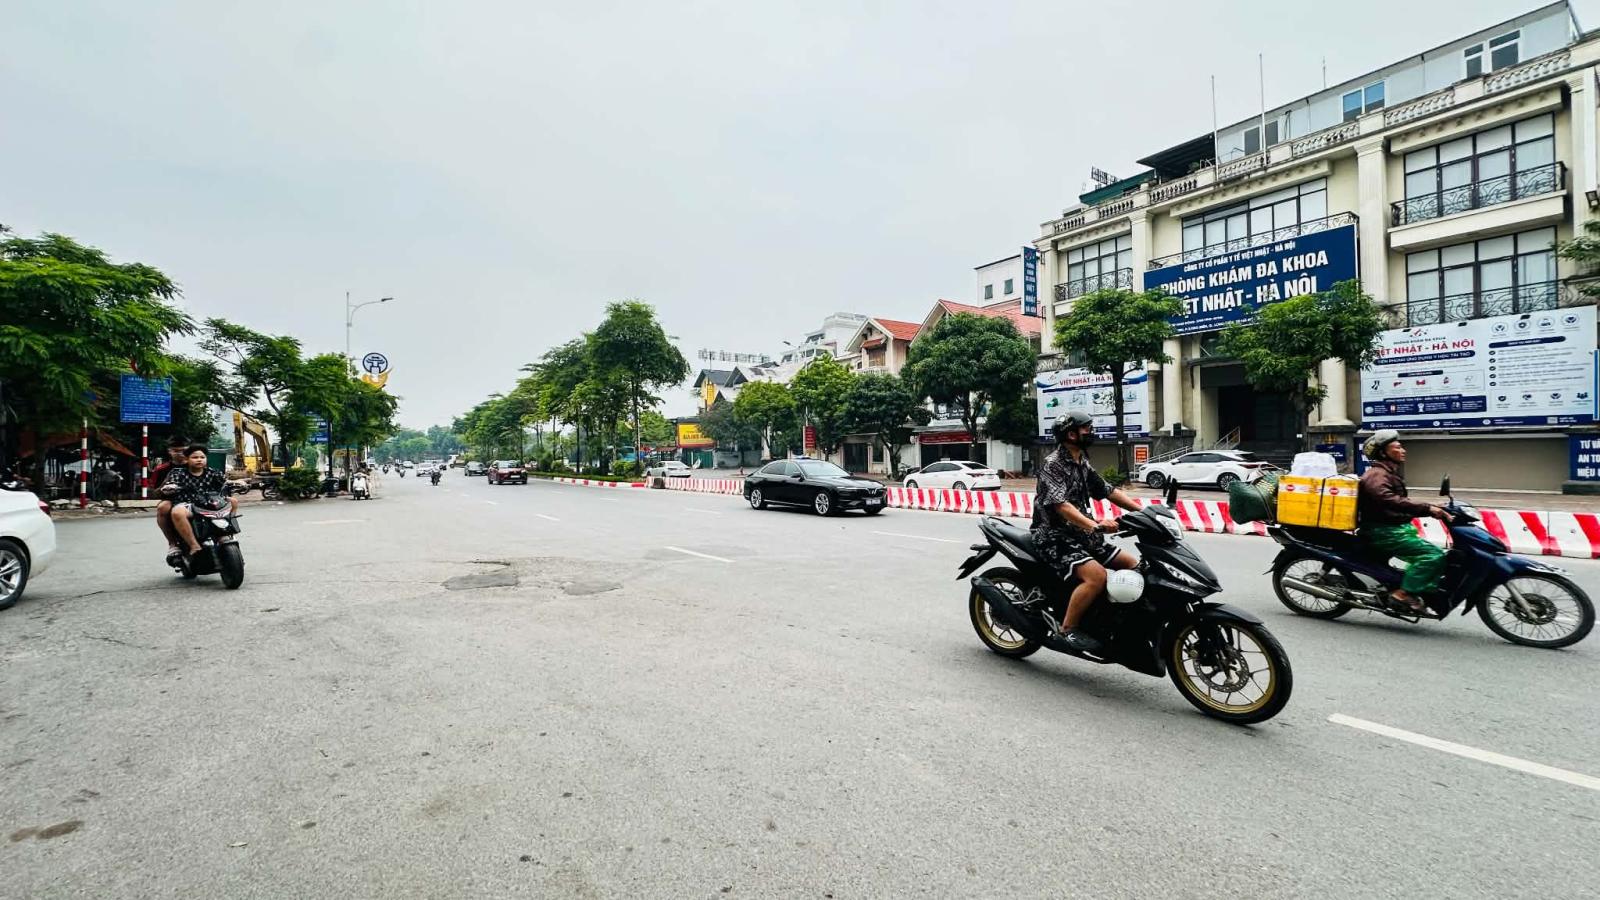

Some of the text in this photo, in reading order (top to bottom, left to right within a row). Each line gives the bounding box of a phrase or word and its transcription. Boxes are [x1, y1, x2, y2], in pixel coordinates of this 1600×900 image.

[1161, 250, 1329, 295] PHÒNG KHÁM ĐA KHOA
[1202, 286, 1244, 312] NHẬT
[1256, 278, 1281, 304] HÀ
[1394, 344, 1422, 354] NHẬT
[1432, 340, 1448, 351] HÀ
[1452, 338, 1474, 350] NỘI
[1578, 454, 1589, 463] AN
